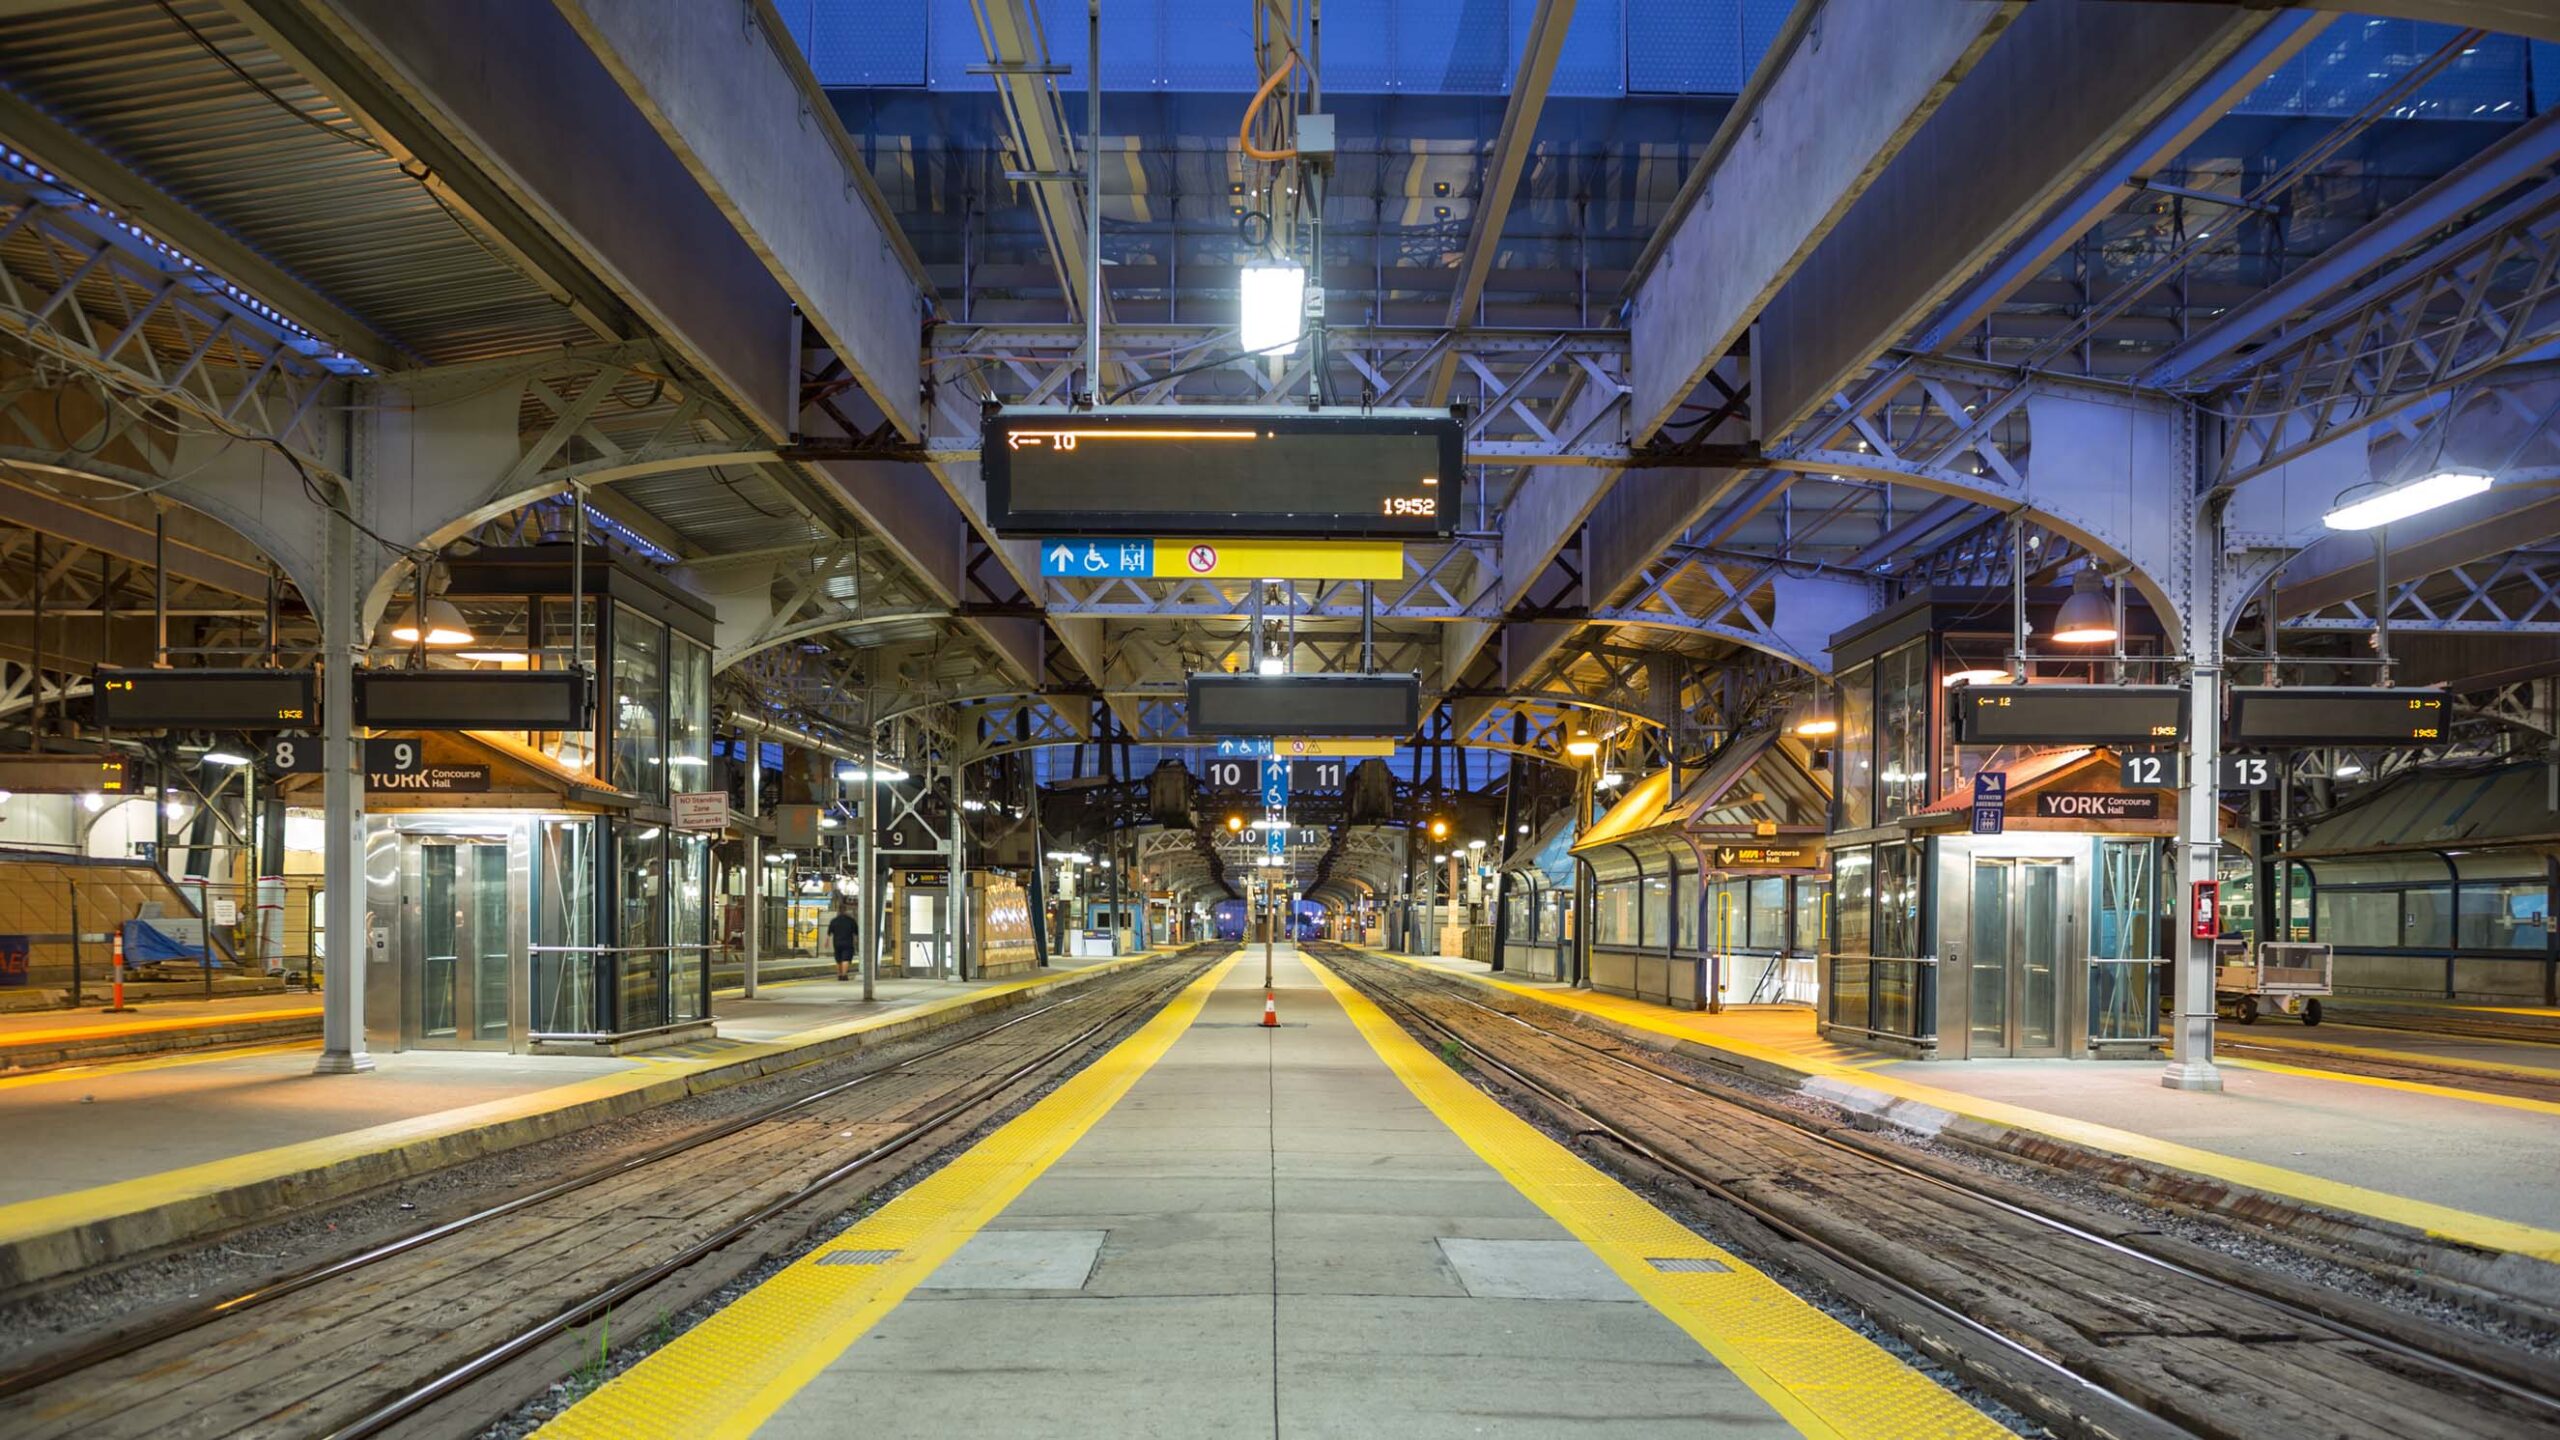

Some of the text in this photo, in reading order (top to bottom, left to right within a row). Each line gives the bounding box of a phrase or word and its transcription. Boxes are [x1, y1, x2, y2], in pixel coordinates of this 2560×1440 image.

[1053, 430, 1076, 450] 10
[1384, 498, 1436, 515] 19:52
[124, 681, 132, 690] 8
[1999, 697, 2011, 706] 12
[2409, 699, 2421, 709] 13
[275, 742, 295, 768] 8
[394, 743, 413, 770] 9
[371, 769, 482, 788] YORK Concourse
[1210, 763, 1240, 786] 10
[1316, 764, 1339, 786] 11
[2128, 757, 2162, 784] 12
[2234, 758, 2268, 785] 13
[431, 779, 451, 788] Hall
[692, 796, 722, 804] Standing
[2046, 796, 2151, 814] YORK Concourse
[2107, 806, 2124, 814] Hall
[892, 832, 904, 846] 9
[1238, 830, 1256, 843] 10
[1300, 830, 1315, 843] 11
